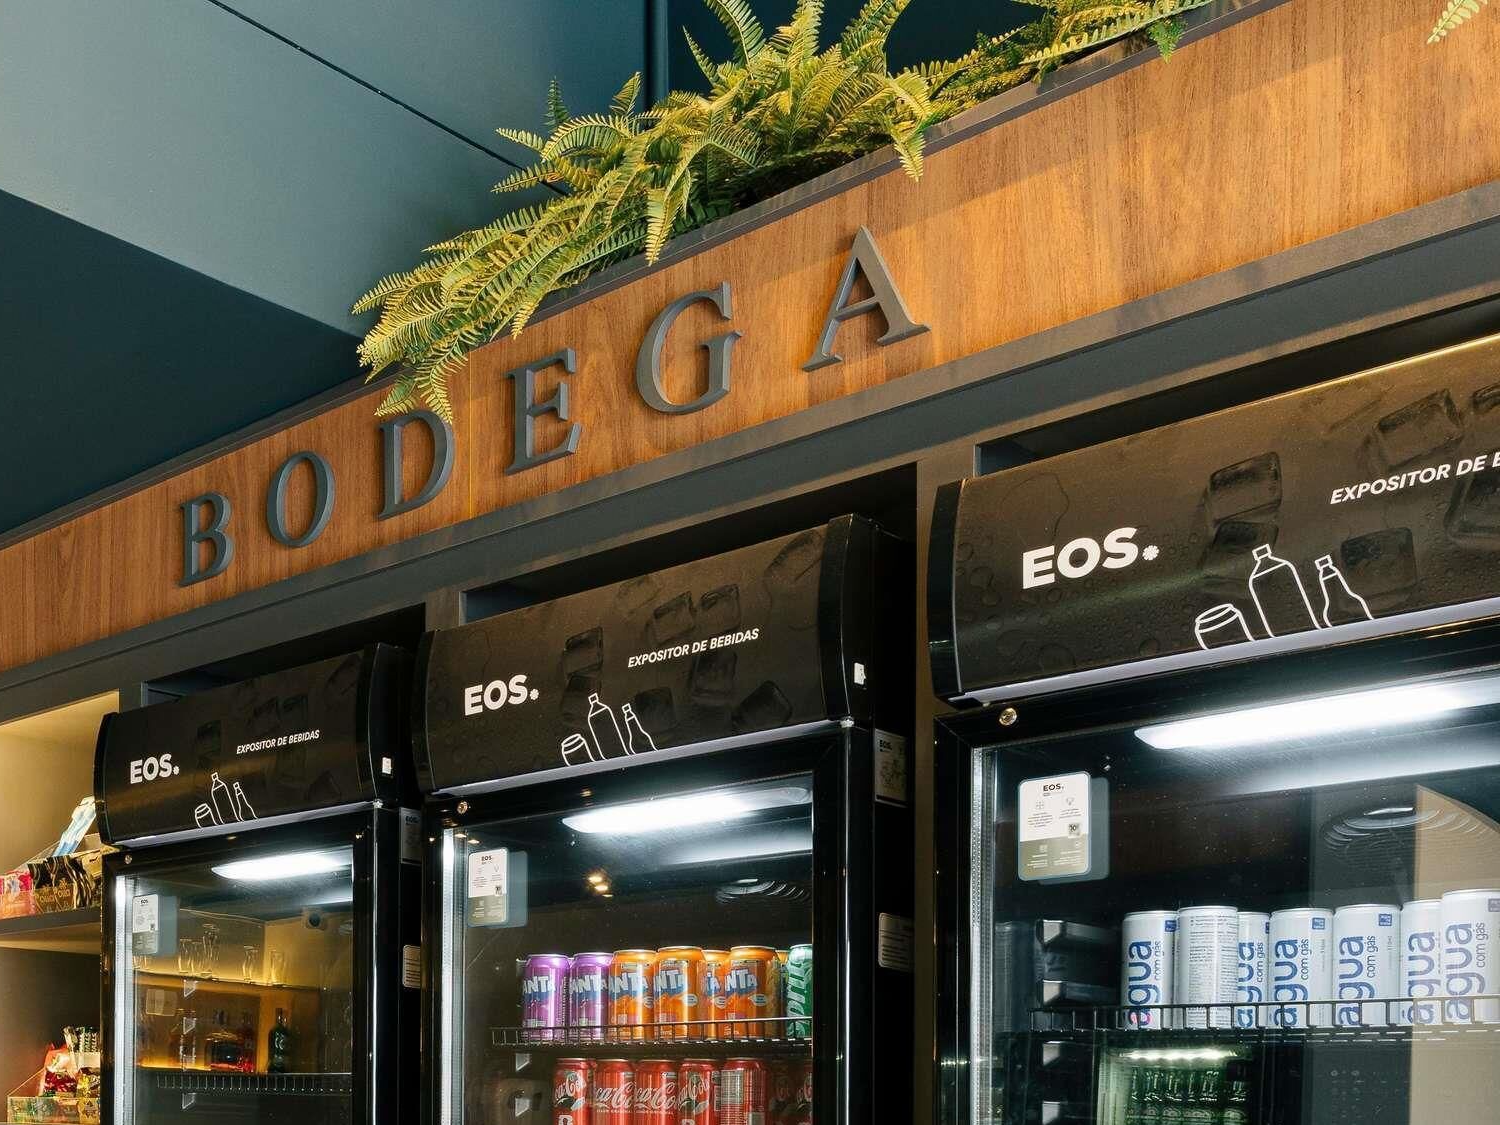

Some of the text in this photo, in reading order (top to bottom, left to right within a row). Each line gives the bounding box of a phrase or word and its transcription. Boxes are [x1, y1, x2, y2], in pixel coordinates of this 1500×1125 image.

[179, 225, 931, 588] BODEGA
[1329, 463, 1451, 505] EXPOSITOR
[1455, 454, 1488, 476] DE
[627, 627, 760, 668] EXPOSITOR DE BEBIDAS
[236, 729, 320, 755] EXPOSITOR DE BEBIDAS
